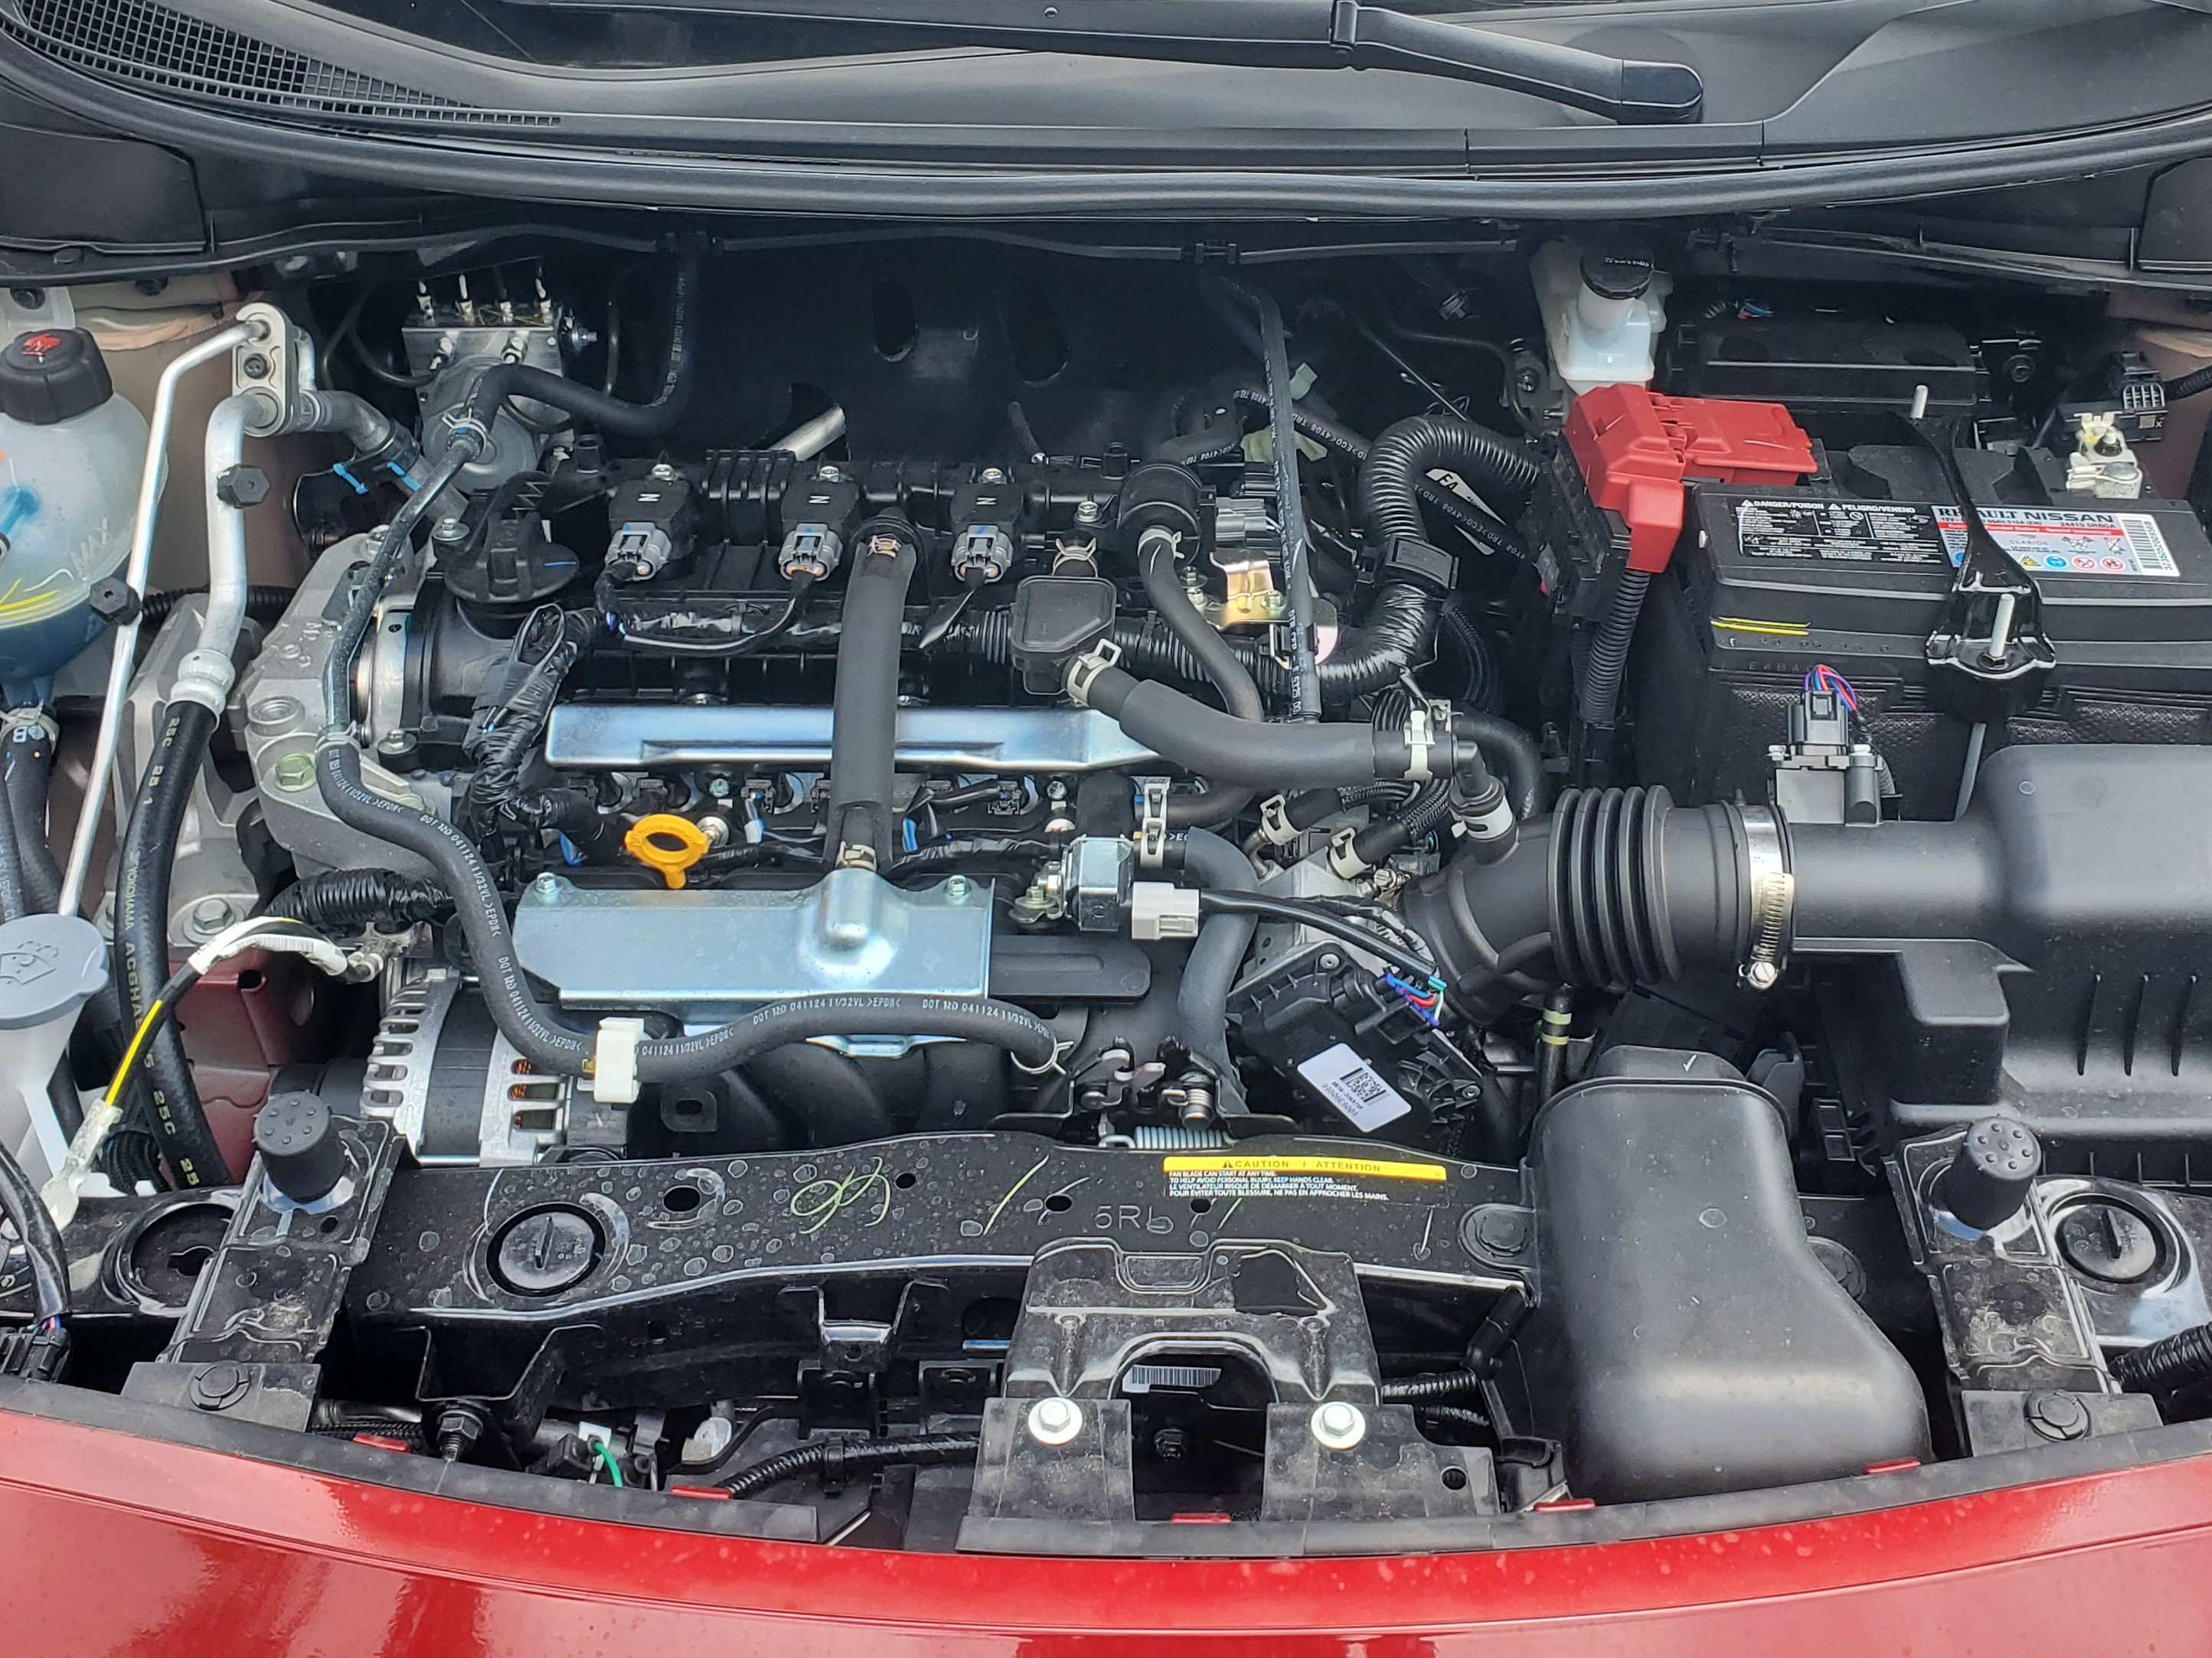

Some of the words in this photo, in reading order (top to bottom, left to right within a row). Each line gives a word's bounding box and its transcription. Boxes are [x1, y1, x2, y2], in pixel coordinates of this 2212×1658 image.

[2024, 511, 2114, 523] NISSAN
[789, 998, 826, 1011] 041124
[923, 999, 940, 1010] DOT
[962, 1003, 998, 1018] 041124
[154, 1089, 176, 1135] 25C
[180, 1158, 201, 1186] 25
[1316, 1161, 1380, 1172] ATTENTION
